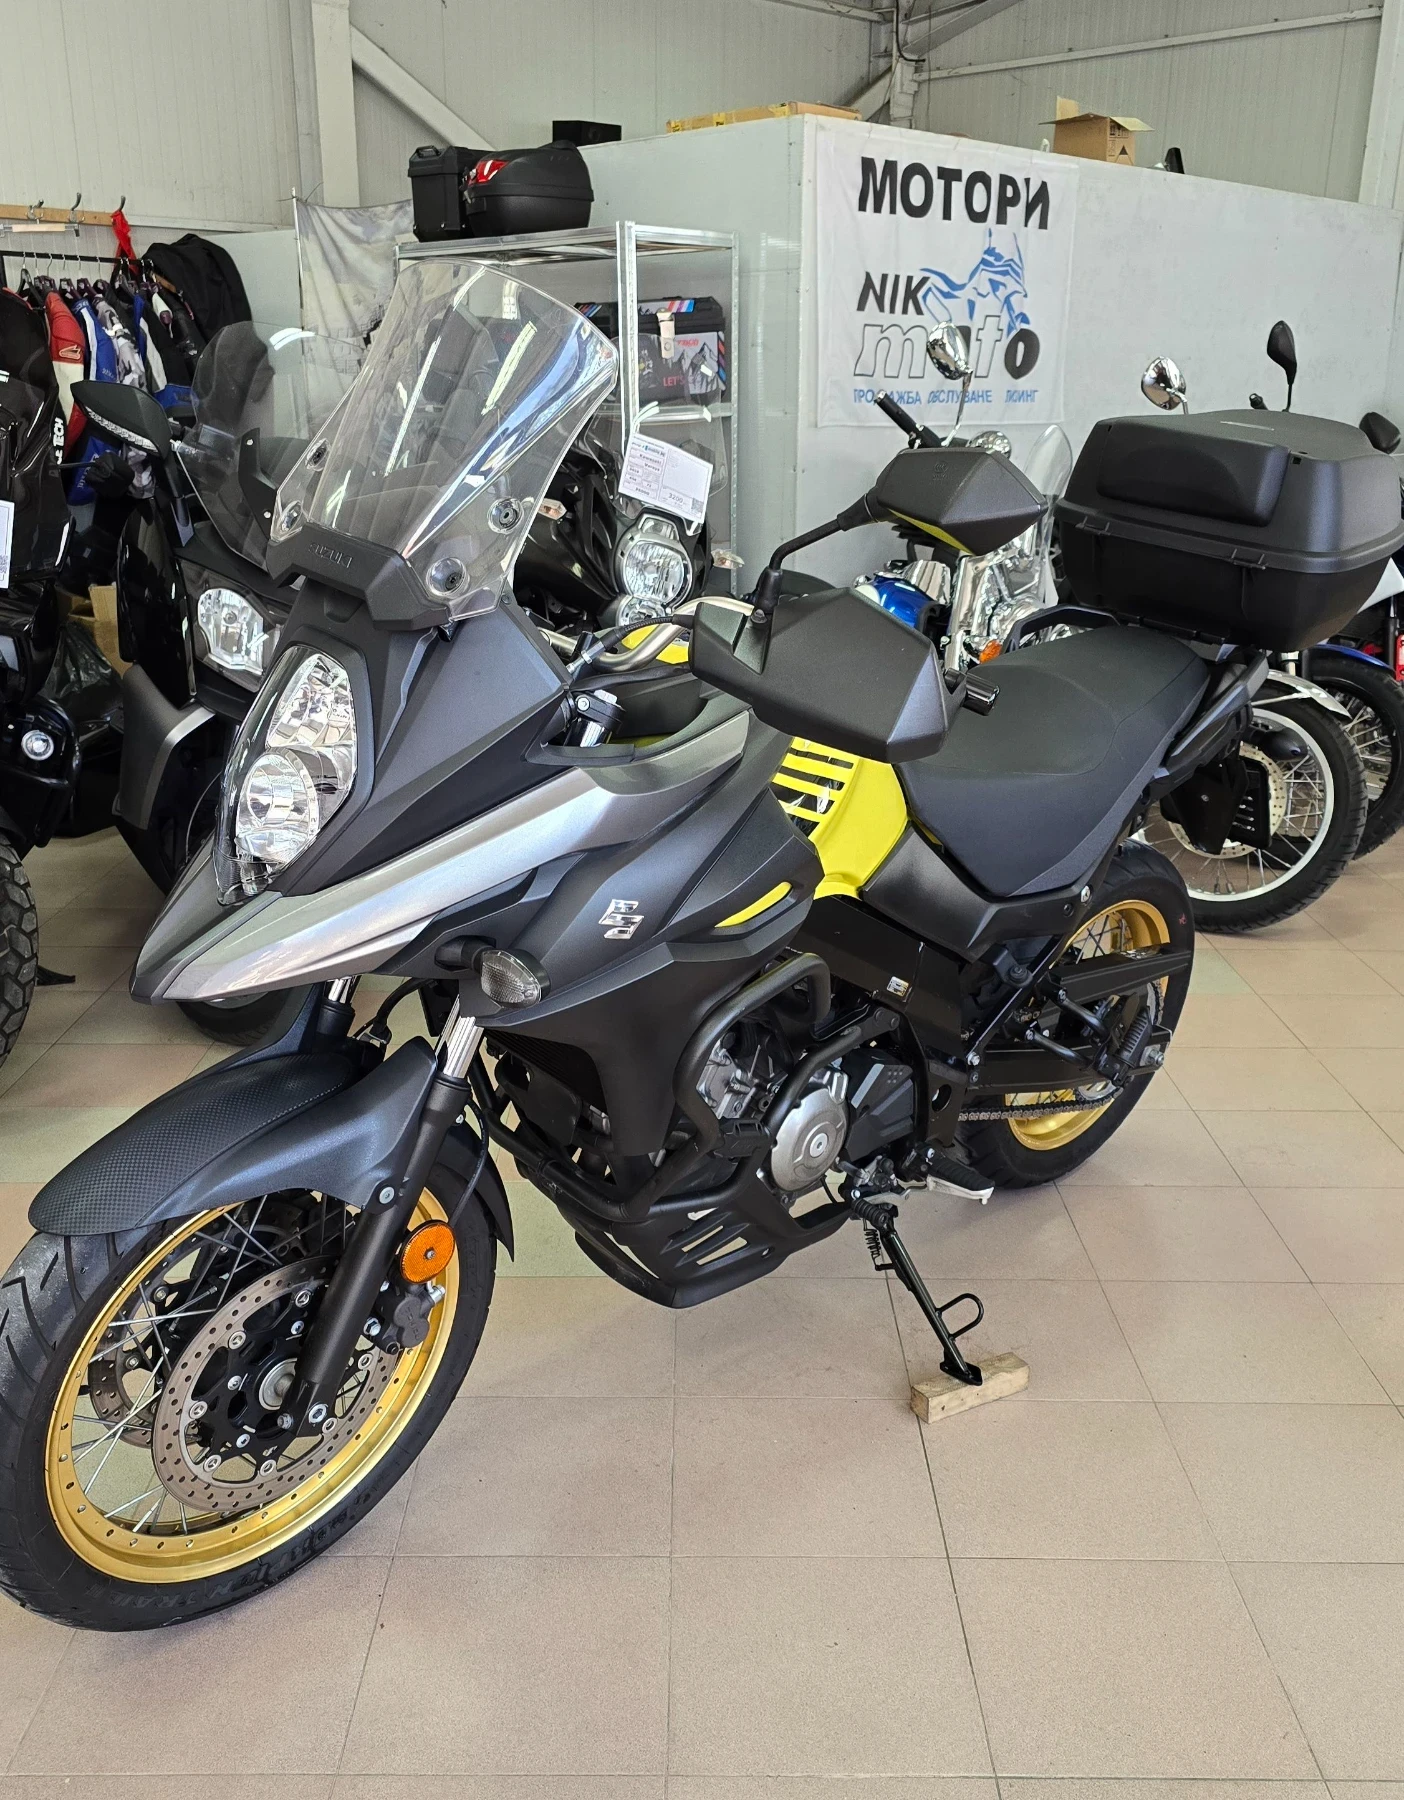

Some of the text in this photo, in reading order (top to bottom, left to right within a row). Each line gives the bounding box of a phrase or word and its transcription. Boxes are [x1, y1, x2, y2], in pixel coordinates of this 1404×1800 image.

[858, 156, 1050, 230] МОТОРИ
[856, 271, 931, 316] NIK
[853, 315, 1040, 380] mto
[853, 388, 922, 405] ПРОАЖБА
[308, 542, 353, 569] SUZUKI
